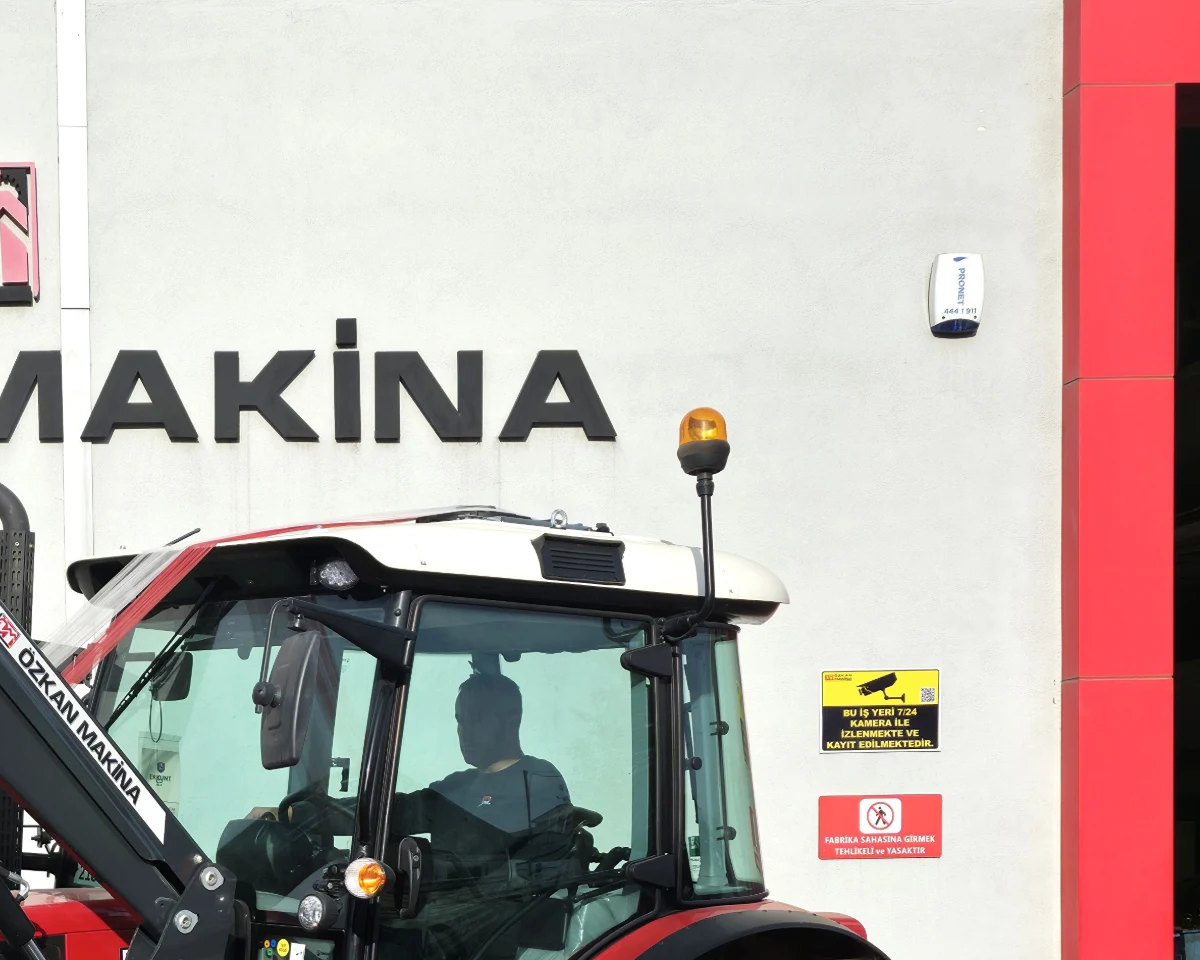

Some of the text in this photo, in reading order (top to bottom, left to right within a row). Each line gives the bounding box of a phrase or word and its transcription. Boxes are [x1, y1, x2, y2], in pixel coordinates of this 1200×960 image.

[843, 708, 917, 718] BU İŞ YERİ 7/24
[18, 647, 142, 805] ÖZKAN MAKİNA
[894, 718, 910, 727] İLE
[841, 729, 920, 738] İZLENMEKTE VE
[826, 740, 934, 749] KAYIT EDİLMEKTEDİR.
[824, 834, 936, 844] FABRİKA SAHASINA GİRMEK
[834, 846, 875, 855] TEHLİKELİ
[886, 847, 926, 855] YASAKTIR
